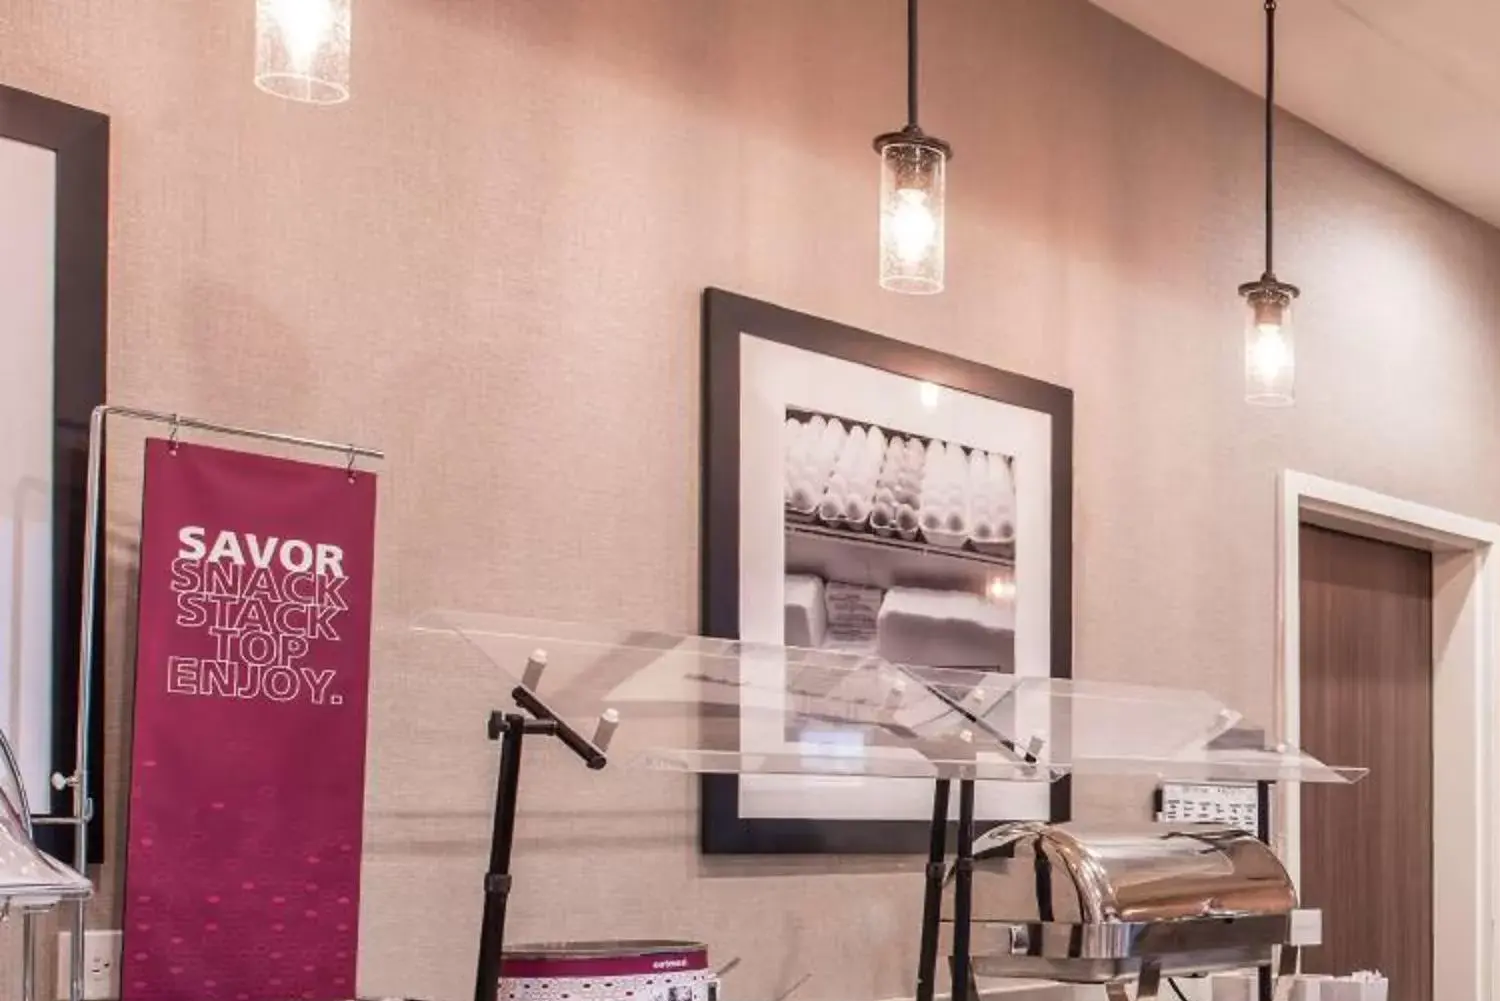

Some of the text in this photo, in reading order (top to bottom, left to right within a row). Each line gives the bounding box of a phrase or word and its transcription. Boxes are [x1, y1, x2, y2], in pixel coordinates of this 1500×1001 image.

[178, 526, 344, 577] SAVOR
[171, 557, 349, 611] SNACK
[176, 590, 341, 641] STACK
[208, 626, 309, 668] TOP
[167, 656, 343, 705] ENJOY.
